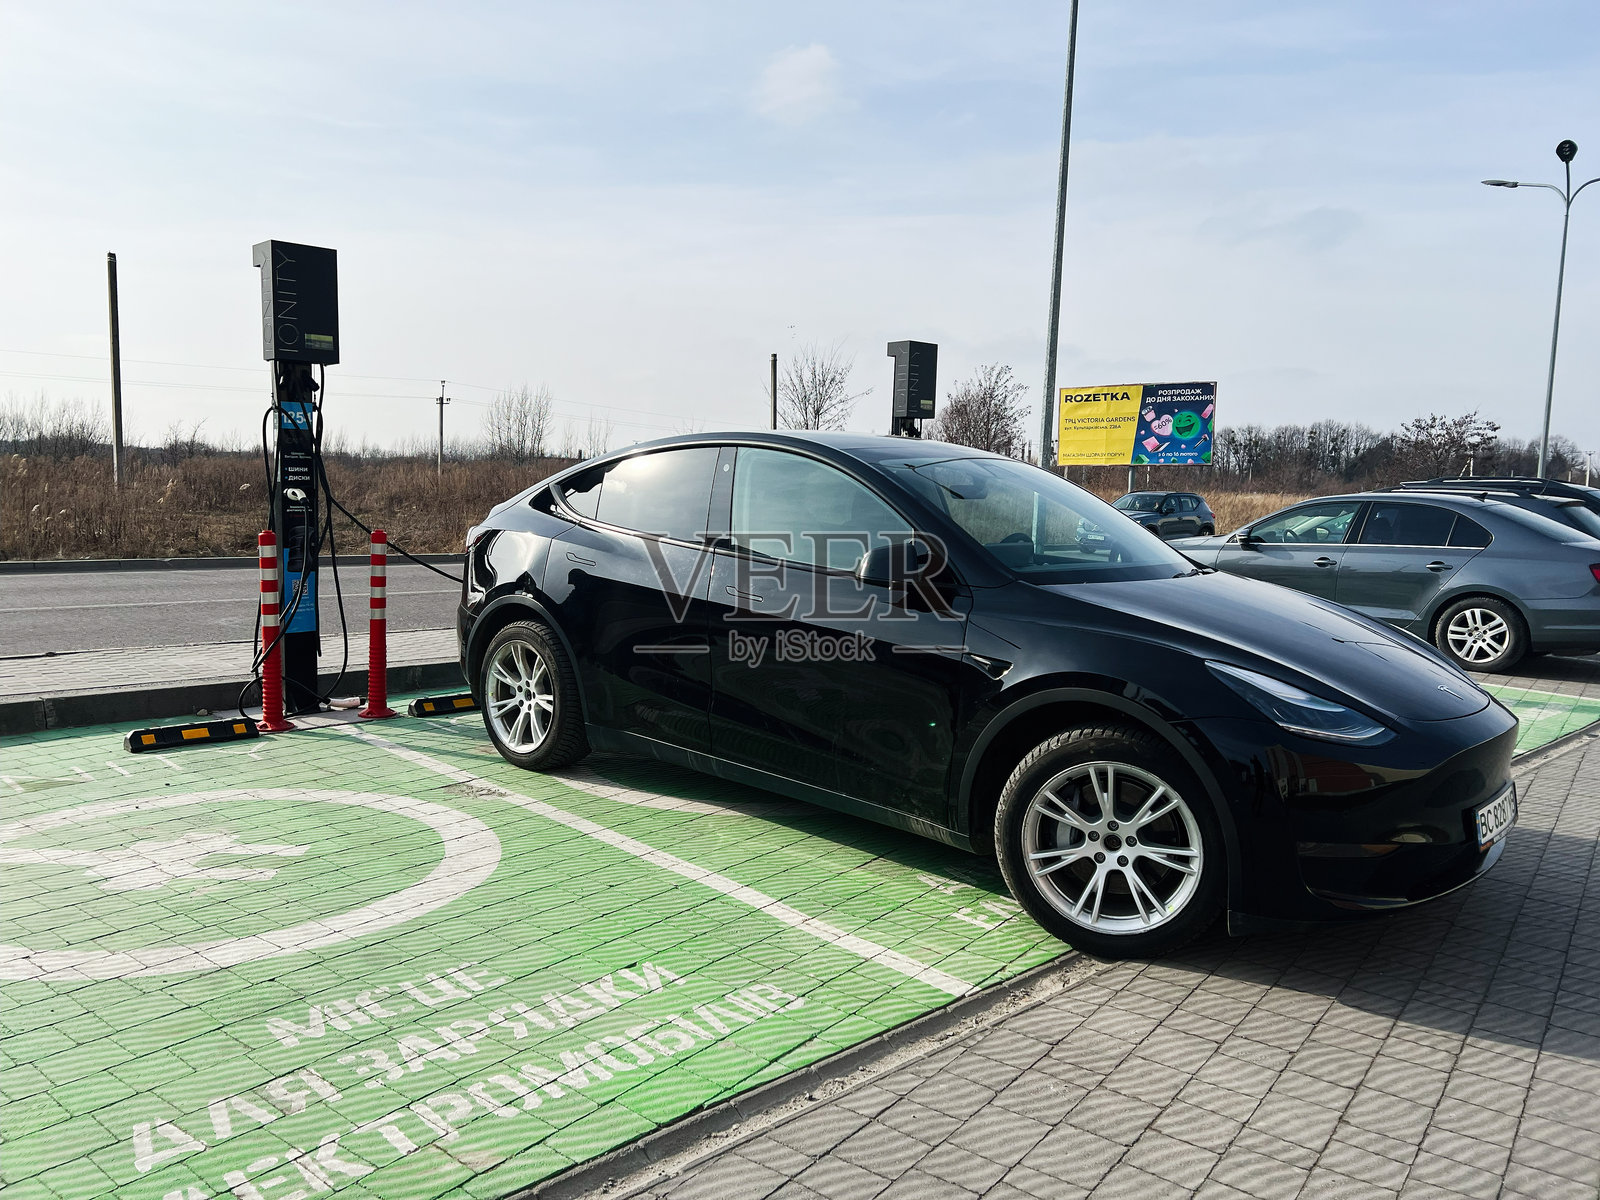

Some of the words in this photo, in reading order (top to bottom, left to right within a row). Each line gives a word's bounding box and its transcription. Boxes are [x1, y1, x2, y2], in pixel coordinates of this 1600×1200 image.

[274, 249, 299, 352] IONITY
[1064, 392, 1131, 403] ROZETKA
[1172, 394, 1215, 402] ЗАКОХАНИХ
[1480, 809, 1494, 839] BC
[266, 961, 507, 1048] МІСЦЕ
[133, 1067, 343, 1173] ДЛЯ
[337, 961, 687, 1090] ЗАРЯДКИ
